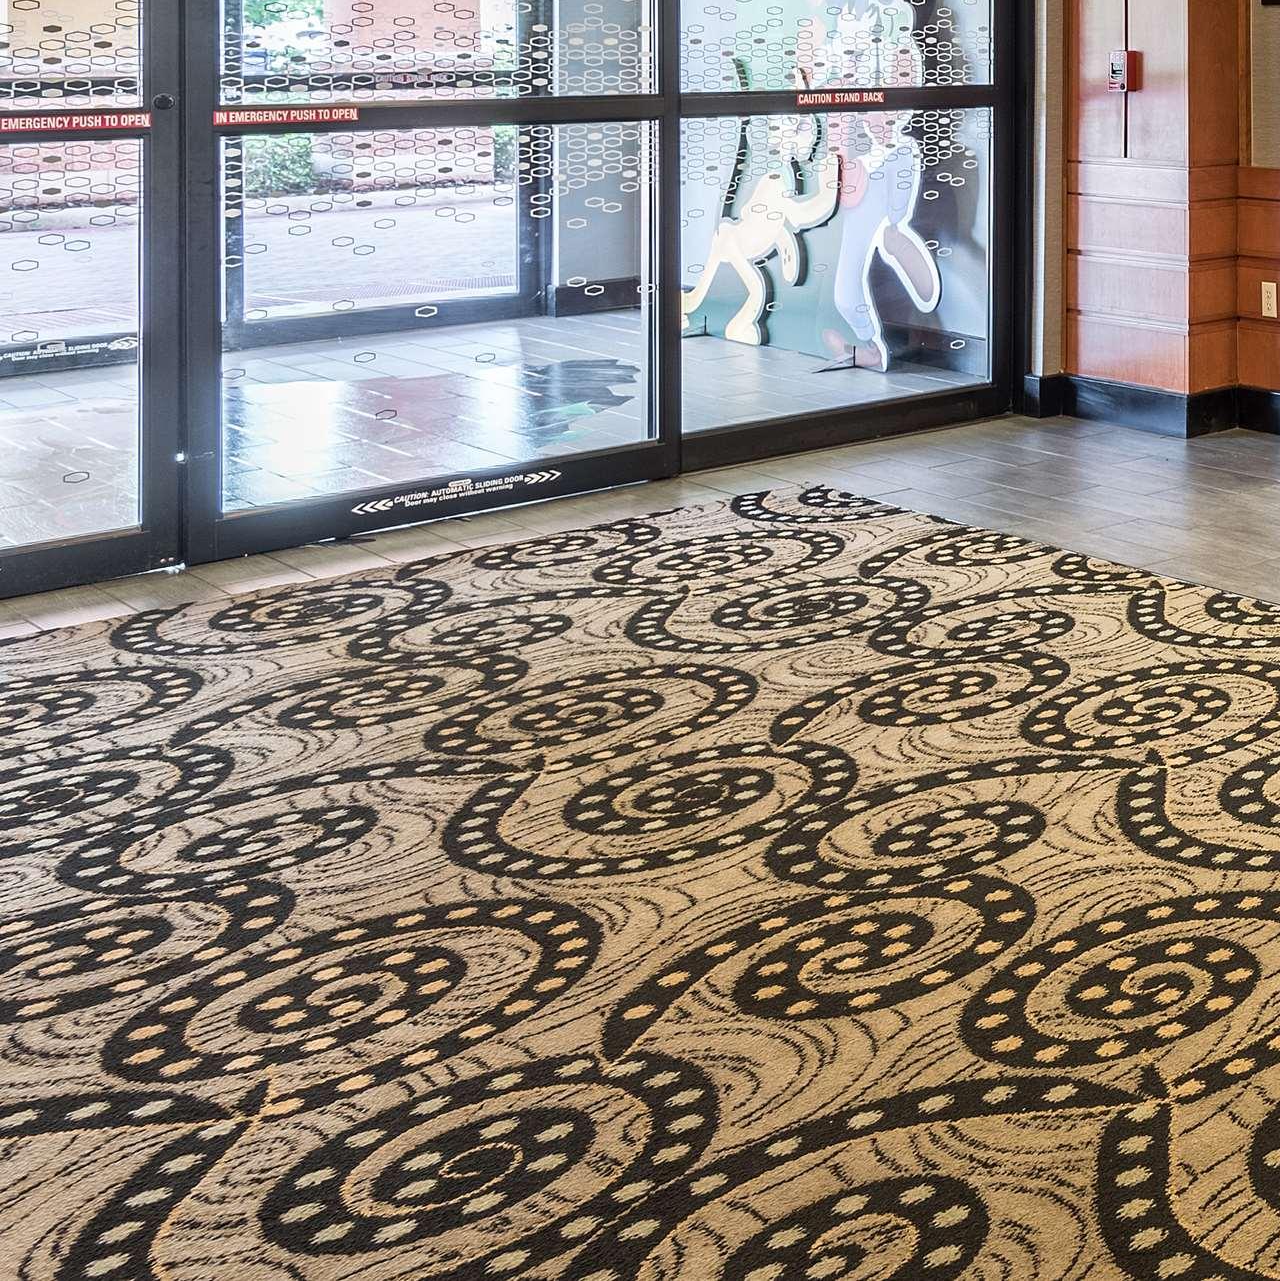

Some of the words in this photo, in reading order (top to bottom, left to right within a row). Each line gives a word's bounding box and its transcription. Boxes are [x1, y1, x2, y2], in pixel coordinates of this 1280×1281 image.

[798, 93, 832, 104] CAUTION
[834, 92, 860, 103] STAND
[863, 92, 884, 103] BACK
[1, 117, 71, 131] EMERGENCY
[72, 115, 102, 128] PUSH
[103, 115, 119, 127] TO
[120, 114, 150, 127] OPEN
[216, 112, 228, 124] IN
[229, 110, 288, 124] EMERGENCY
[289, 109, 316, 121] PUSH
[318, 109, 331, 120] TO
[332, 108, 358, 120] OPEN
[394, 492, 428, 504] CAUTION:
[431, 485, 474, 497] AUTOMATIC
[475, 478, 503, 489] SLIDING
[504, 475, 524, 484] DOOR
[404, 499, 422, 507] Door
[423, 496, 438, 505] may
[459, 488, 485, 498] without
[486, 483, 513, 493] warning
